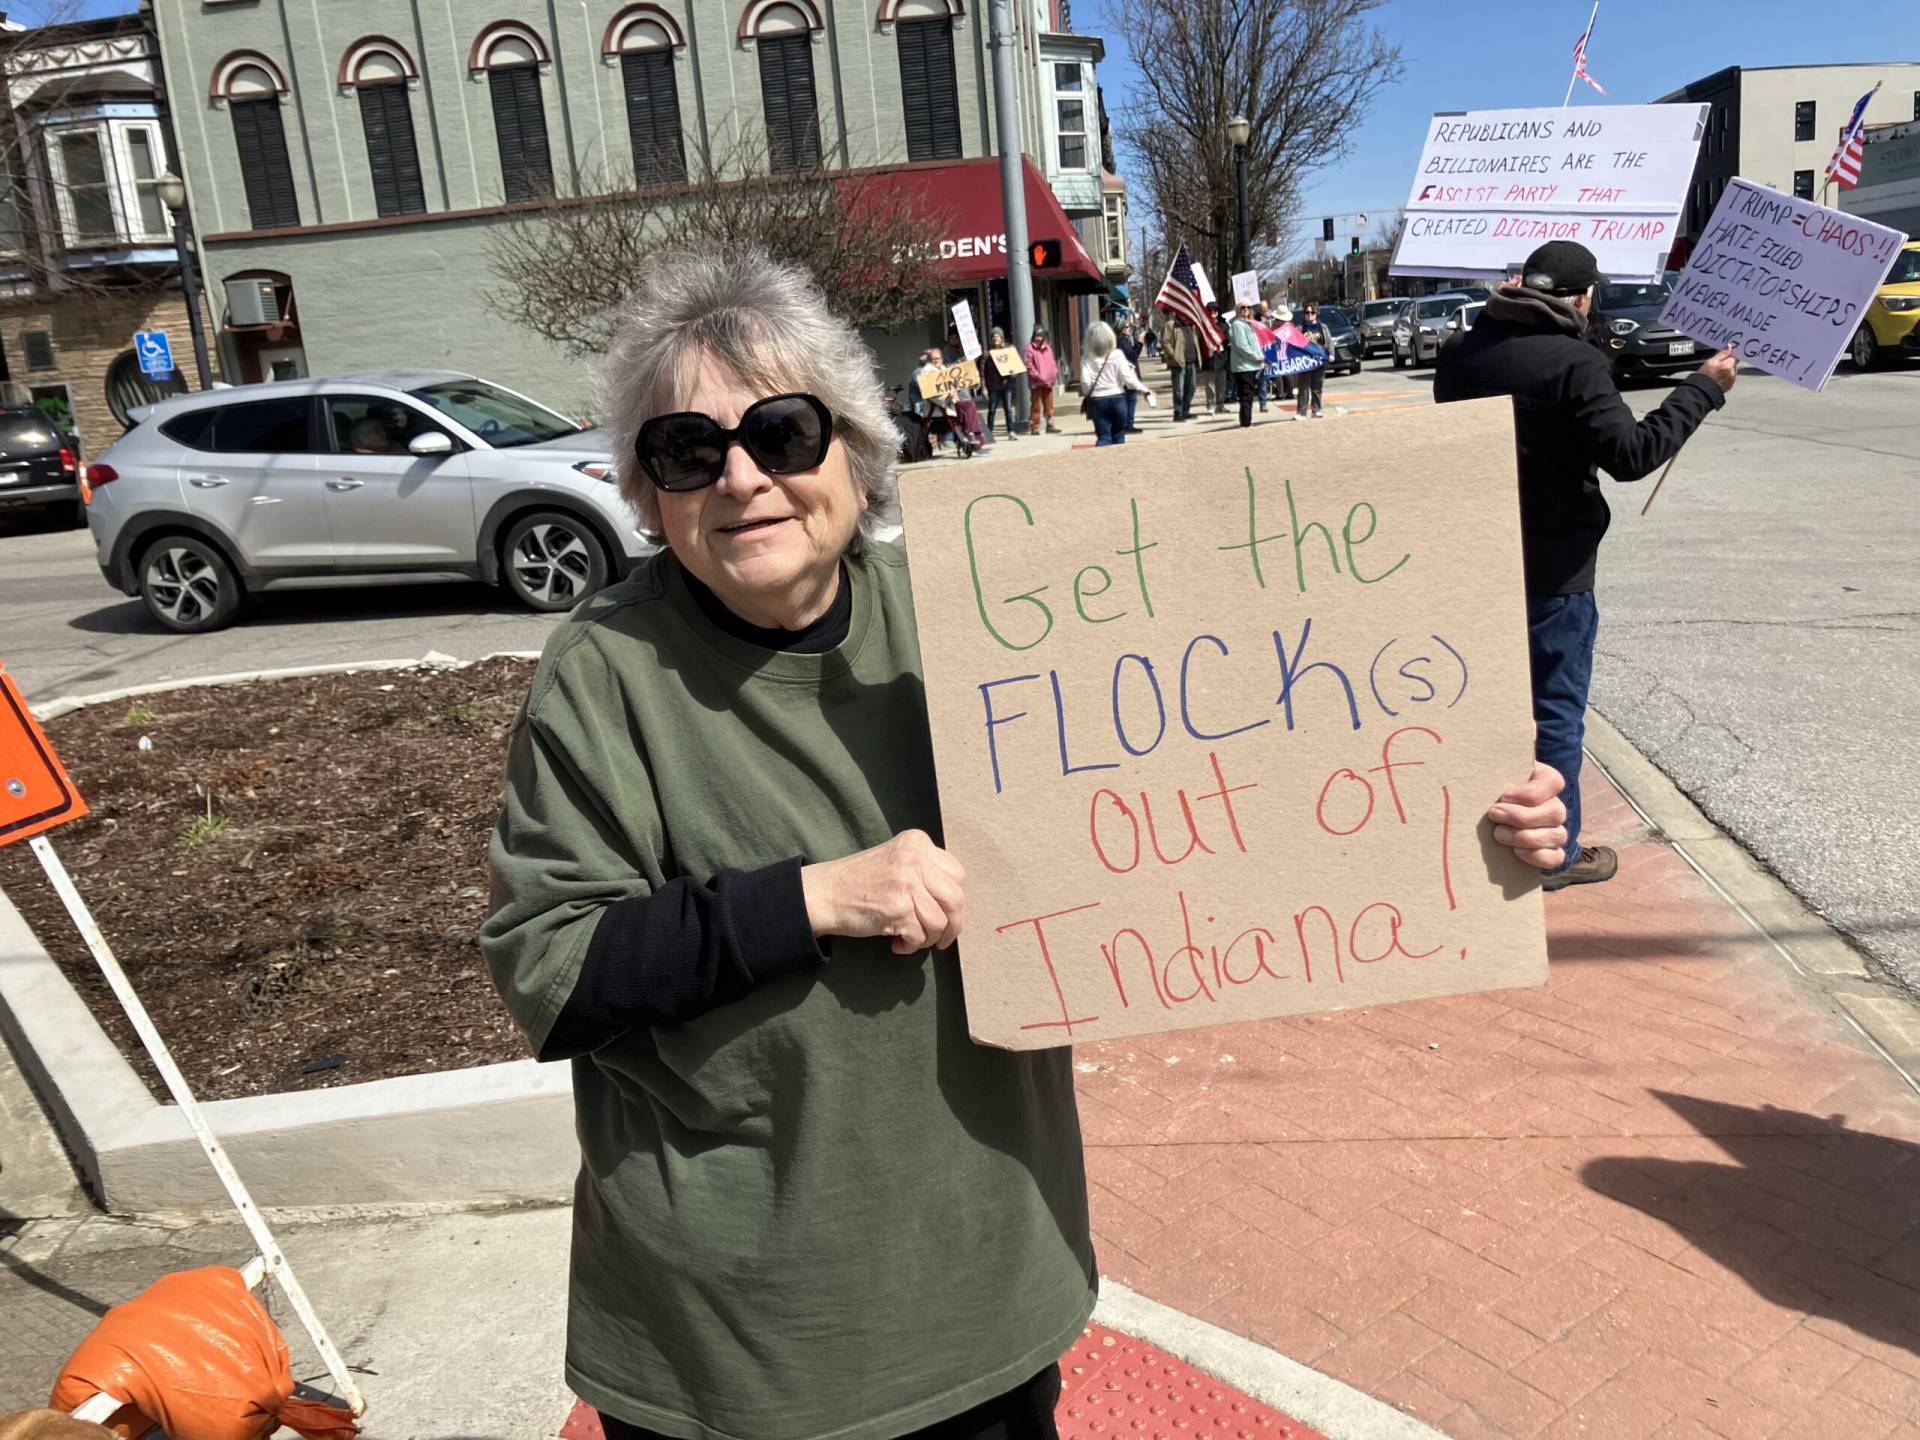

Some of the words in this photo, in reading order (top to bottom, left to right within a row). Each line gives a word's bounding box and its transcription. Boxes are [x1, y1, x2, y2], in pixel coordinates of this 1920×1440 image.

[1433, 120, 1554, 143] REPUBLICANS
[1563, 119, 1601, 138] AND
[1424, 155, 1552, 174] BILLIONAIRES
[1561, 152, 1596, 170] ARE
[1613, 151, 1648, 168] THE
[1418, 185, 1499, 202] FASCIST
[1504, 184, 1558, 203] PARTY
[1577, 187, 1626, 203] THAT
[1411, 217, 1488, 237] CREATED
[1492, 217, 1581, 239] DICTATOR
[1591, 218, 1665, 240] TRUMP
[1708, 217, 1760, 249] HATE
[1755, 236, 1803, 271] FILLED
[1678, 276, 1731, 313] NEVER
[1726, 300, 1778, 333] MADE
[1692, 243, 1857, 327] DICTATORSHIPS
[936, 366, 962, 384] NO
[963, 493, 1158, 651] Get
[1217, 465, 1411, 593] the
[1089, 752, 1258, 873] out
[1315, 725, 1443, 836] of
